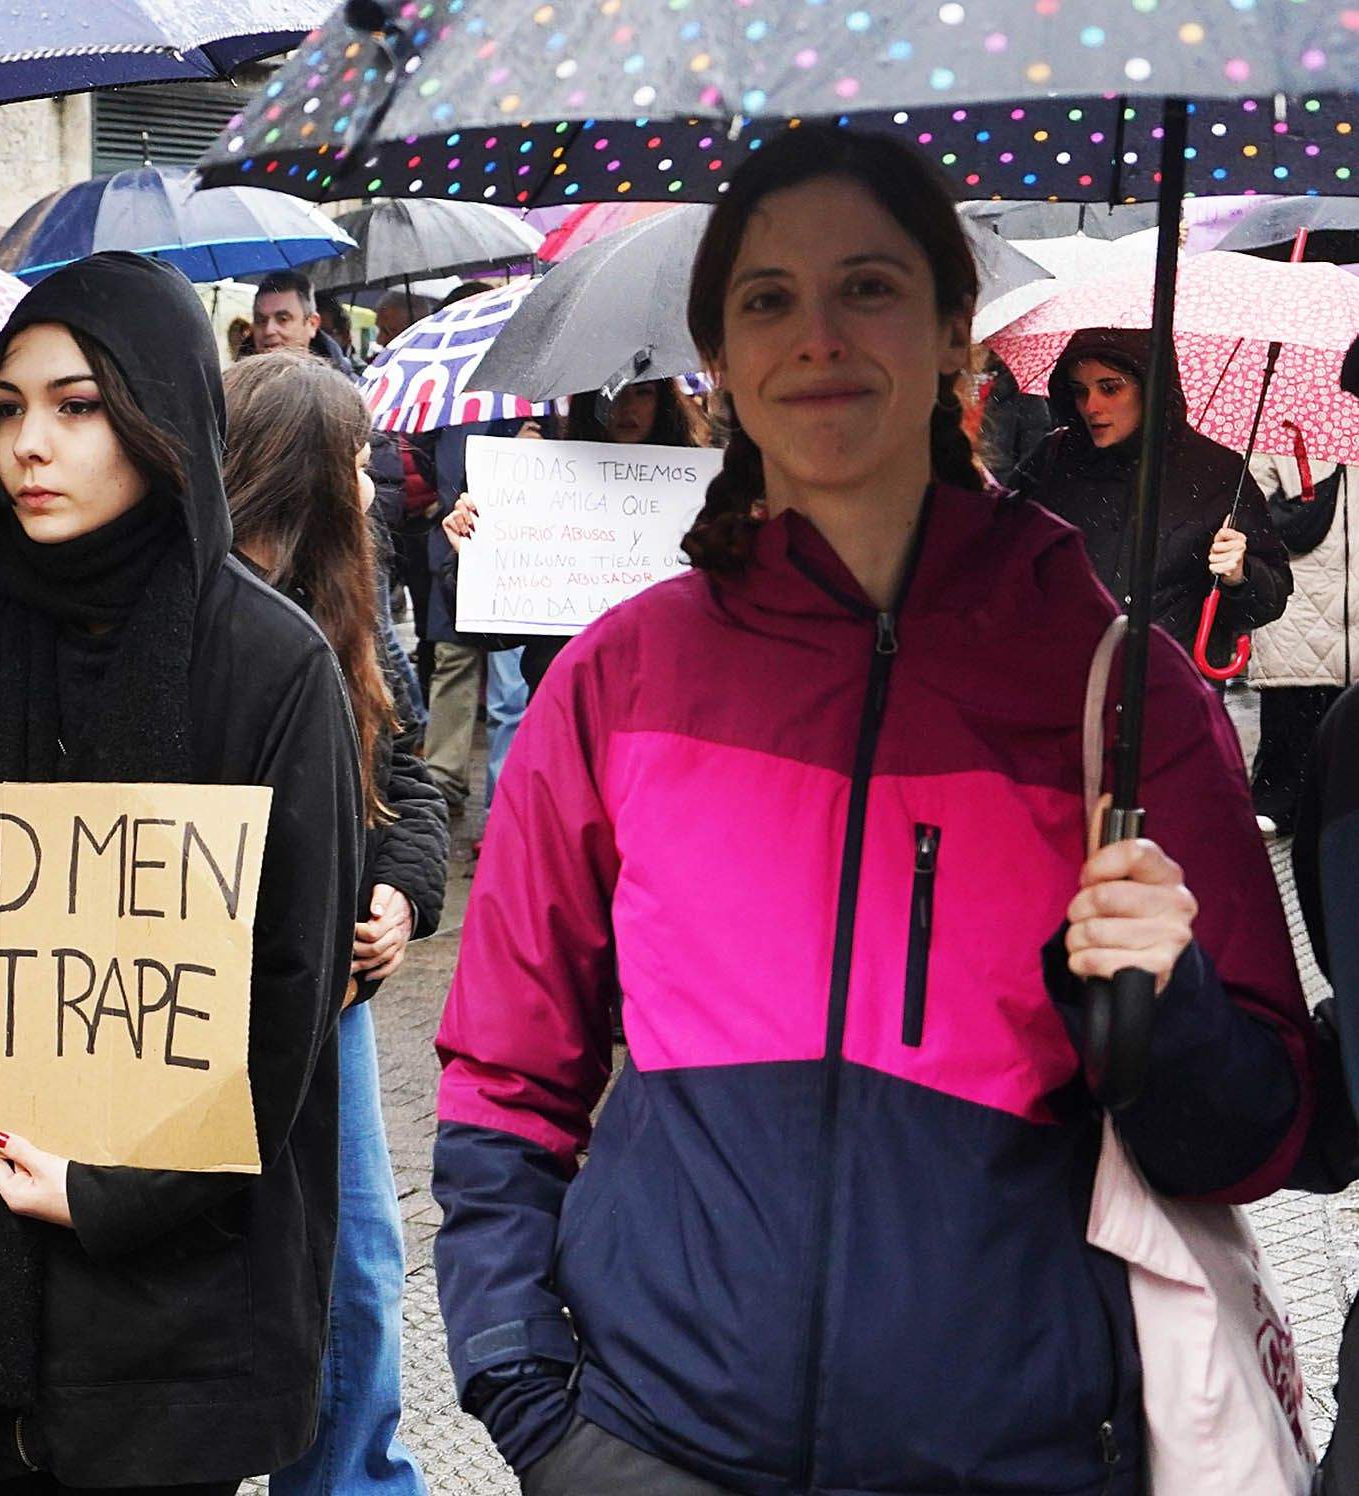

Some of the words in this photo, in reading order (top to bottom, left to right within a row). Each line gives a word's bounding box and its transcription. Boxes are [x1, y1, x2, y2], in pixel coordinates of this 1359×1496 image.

[482, 451, 578, 484] TODAS
[597, 460, 698, 483] TENEMOS
[487, 487, 527, 508] UNA
[622, 494, 660, 517] QUE
[560, 524, 616, 542] ABUSOS
[494, 547, 578, 571] NINGUNO
[590, 552, 651, 569] TIENE
[496, 574, 554, 593] AMIGO
[566, 571, 654, 586] ABUSADOR
[548, 597, 577, 617] DA
[587, 597, 610, 614] LA
[68, 813, 249, 920] MEN
[51, 948, 217, 1071] RAPE
